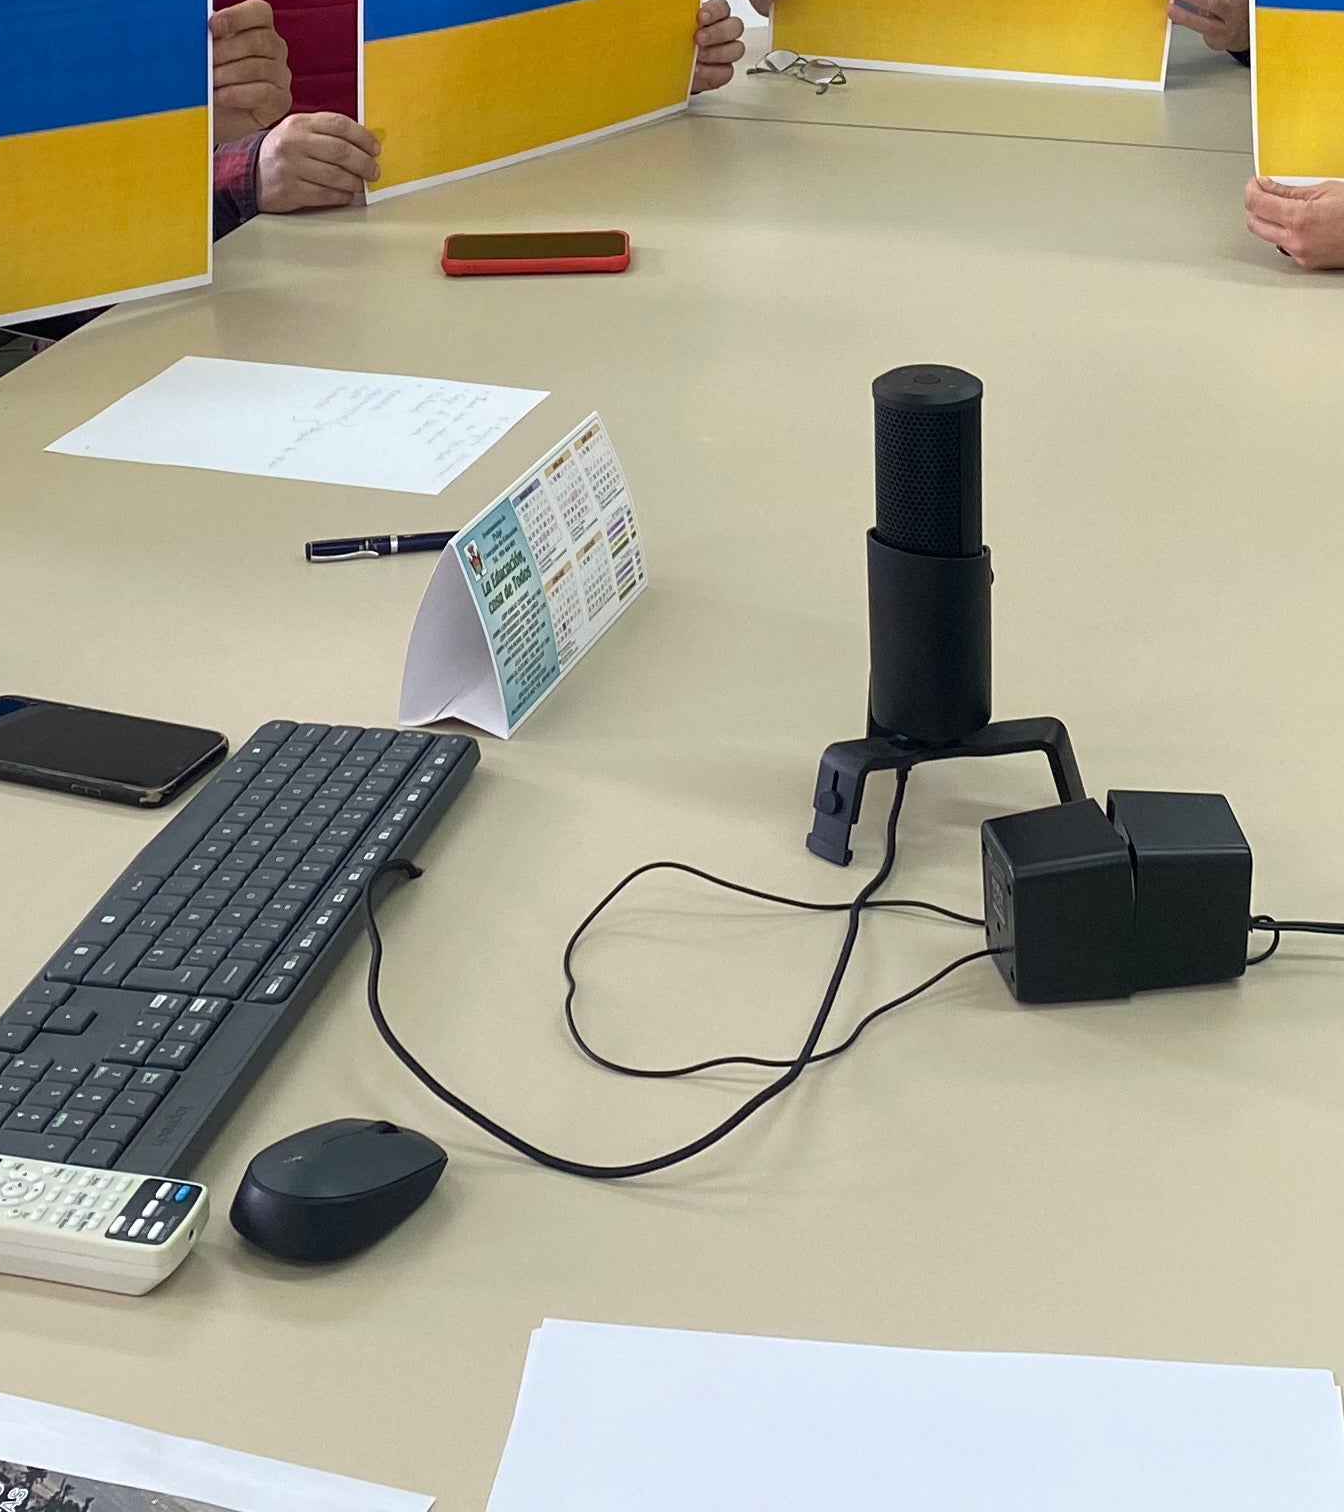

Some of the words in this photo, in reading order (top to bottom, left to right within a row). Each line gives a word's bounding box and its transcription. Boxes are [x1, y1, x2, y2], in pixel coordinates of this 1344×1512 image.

[481, 580, 492, 597] La
[488, 591, 504, 615] cosa
[503, 582, 514, 600] de
[512, 565, 532, 591] Todos
